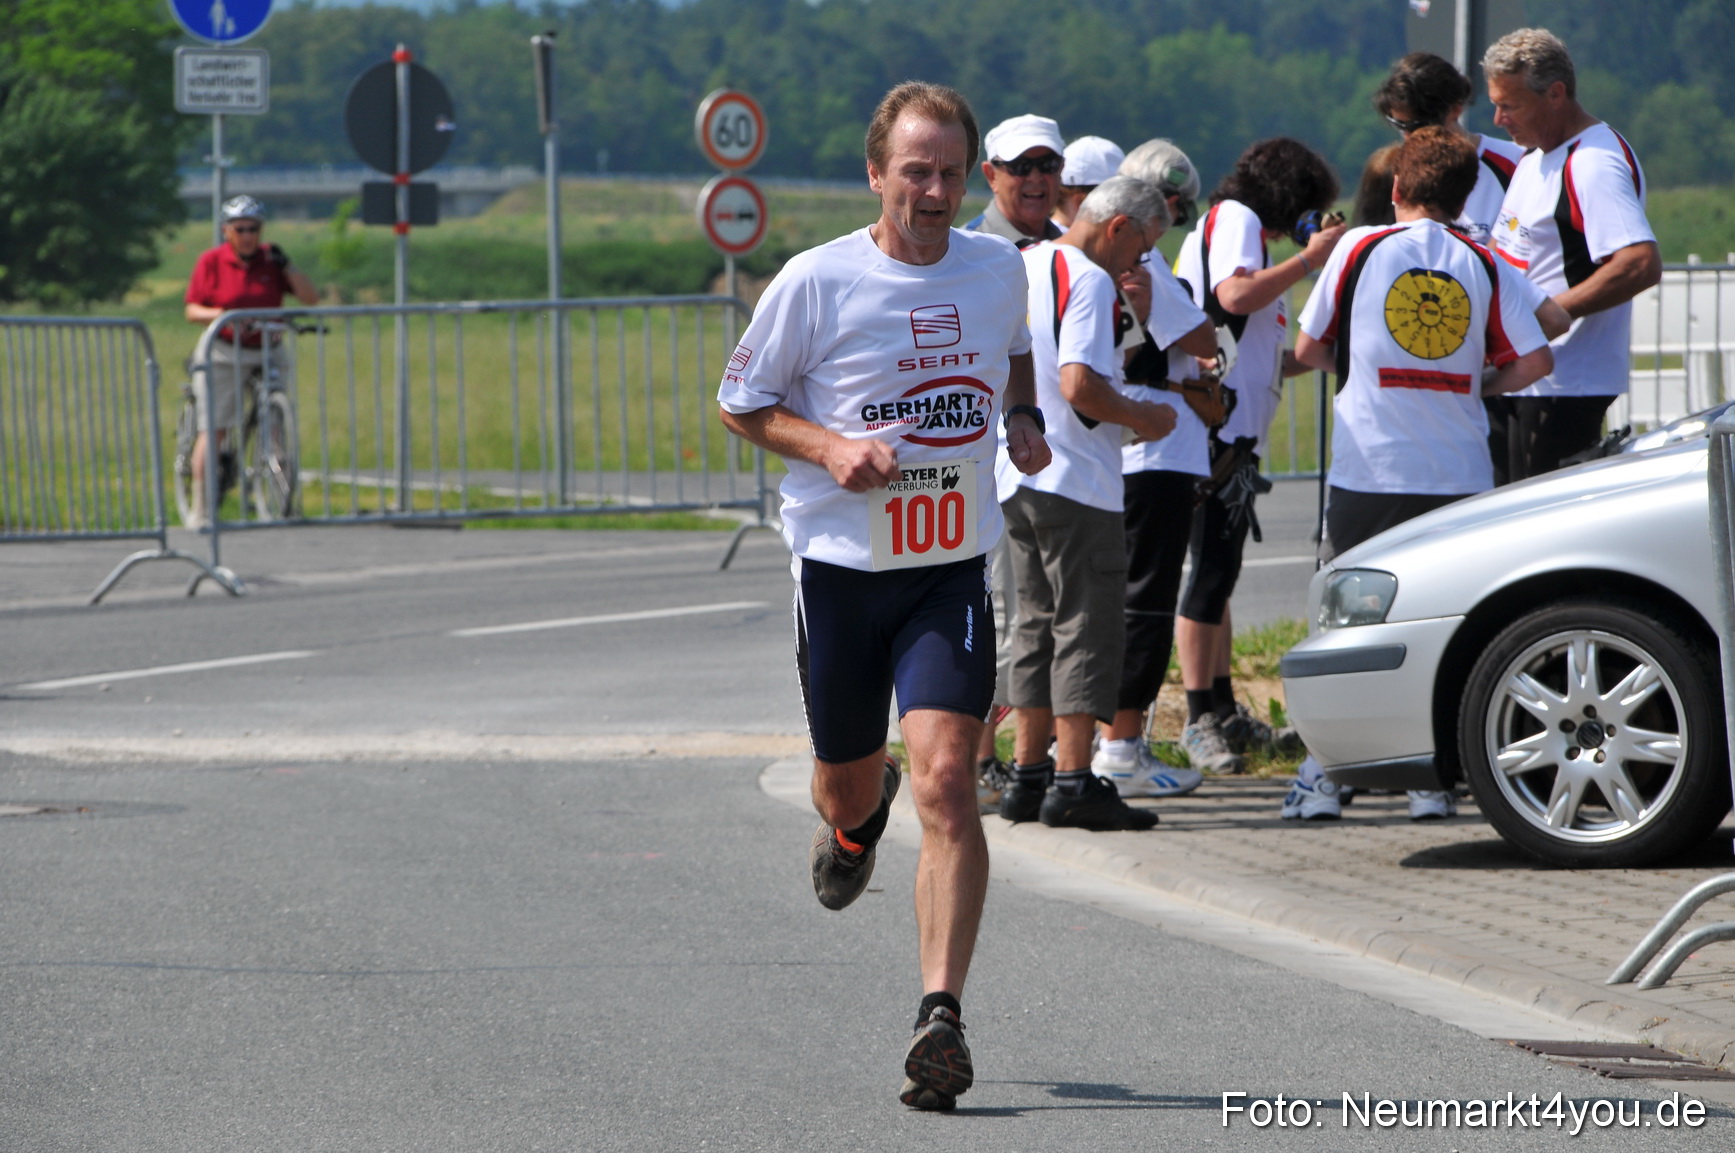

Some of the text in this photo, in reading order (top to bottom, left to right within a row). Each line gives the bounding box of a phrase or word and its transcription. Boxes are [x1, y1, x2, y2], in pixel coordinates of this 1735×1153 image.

[717, 113, 752, 148] 60
[897, 352, 980, 372] SEAT
[861, 393, 976, 422] GERHART
[887, 480, 939, 492] WERBUNG
[895, 466, 938, 482] EYER
[885, 491, 965, 556] 100
